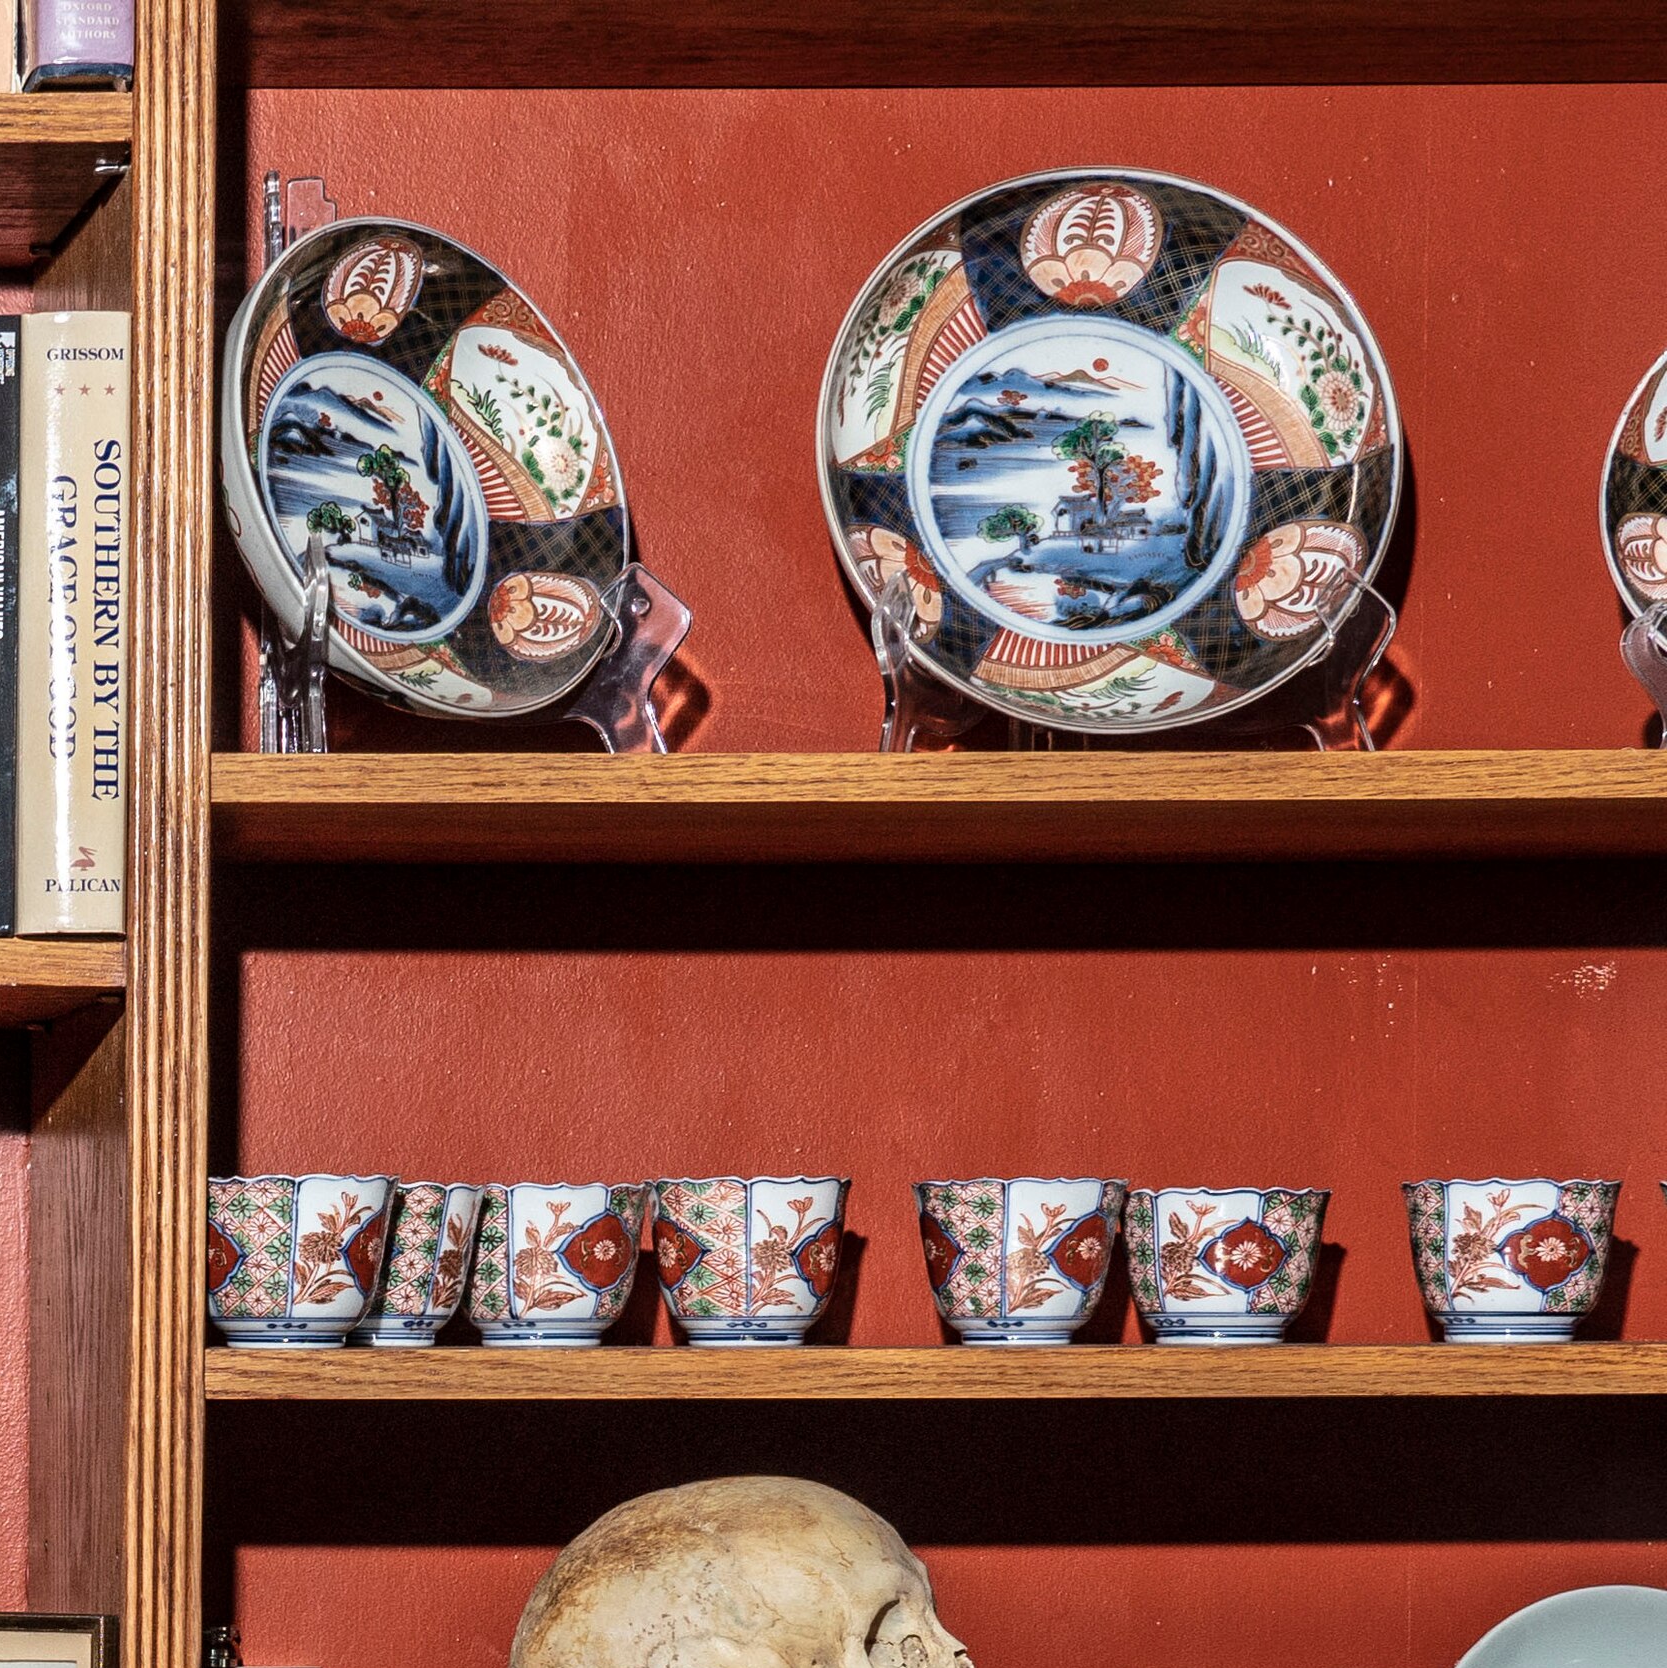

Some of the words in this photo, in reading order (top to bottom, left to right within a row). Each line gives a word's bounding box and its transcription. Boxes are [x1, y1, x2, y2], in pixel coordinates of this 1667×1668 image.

[47, 348, 123, 360] GRISSOM
[93, 440, 121, 648] SOUTHERN
[94, 661, 118, 713] BY
[92, 721, 119, 800] THE
